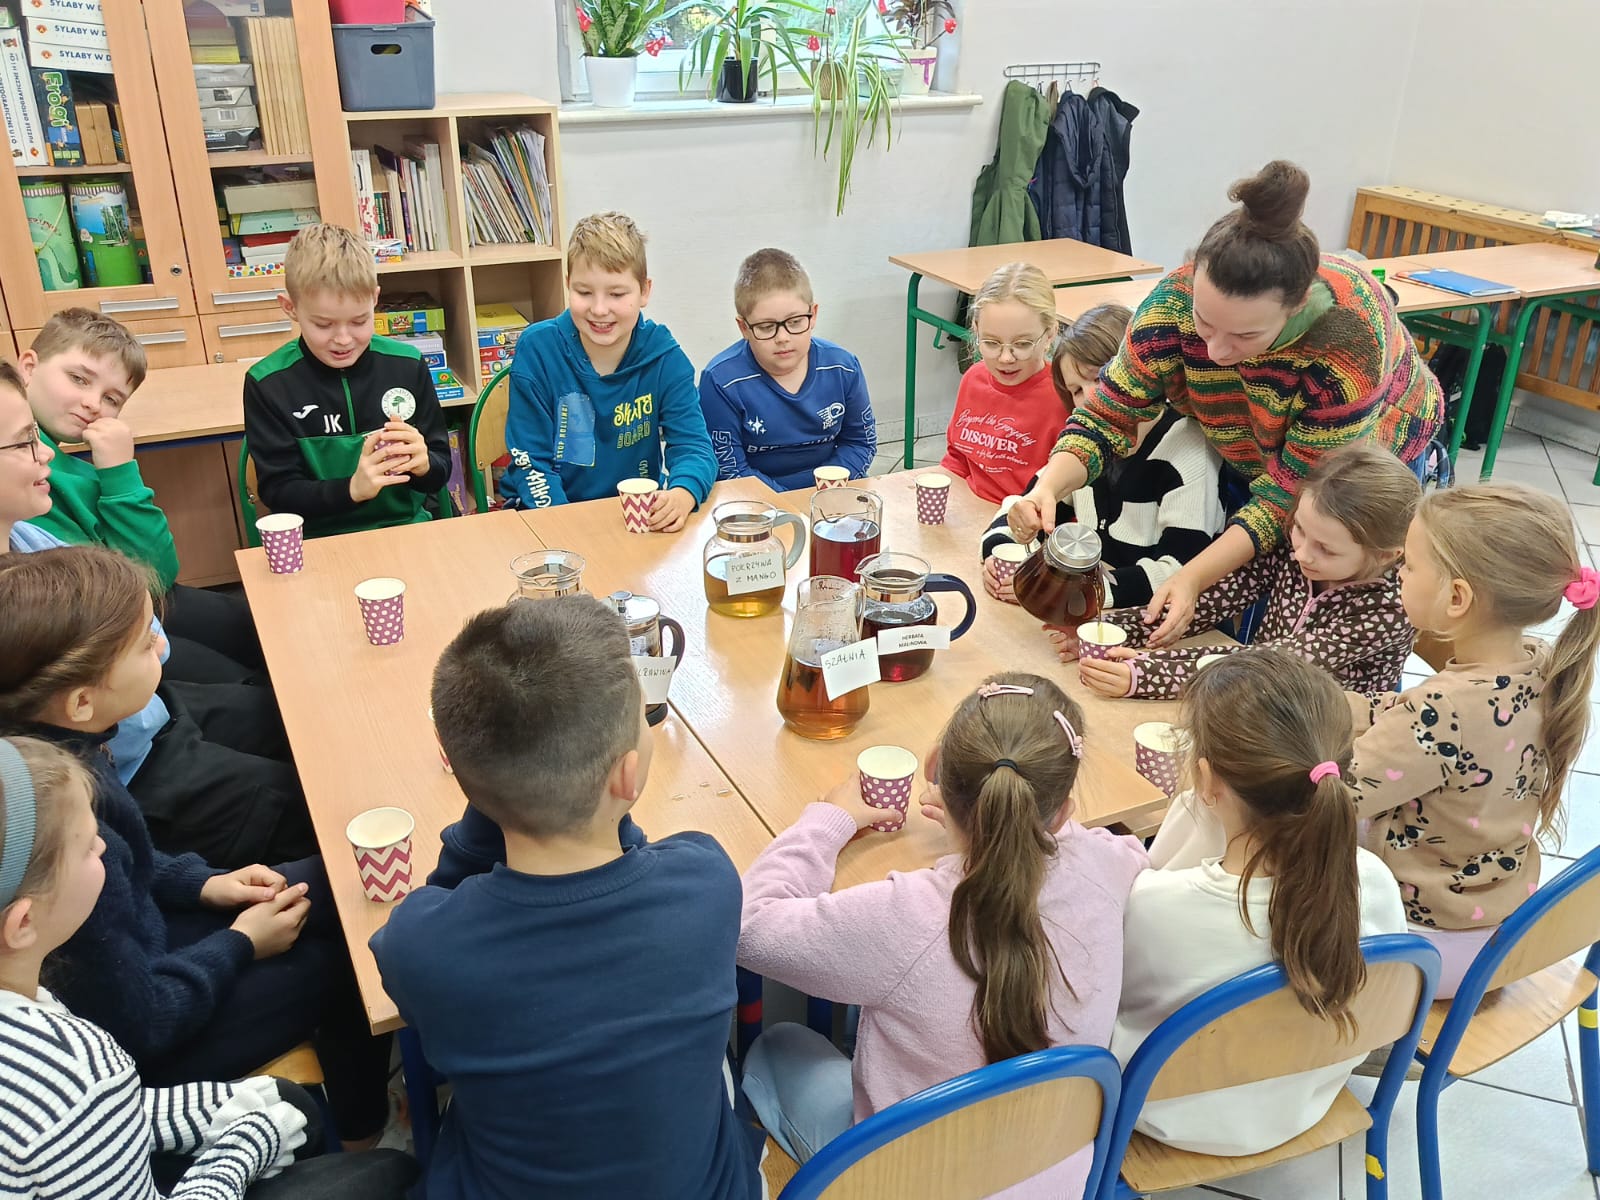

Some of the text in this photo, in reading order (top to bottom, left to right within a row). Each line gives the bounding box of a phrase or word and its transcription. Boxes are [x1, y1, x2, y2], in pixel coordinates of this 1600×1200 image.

[50, 0, 83, 9] SYLABY
[55, 25, 87, 34] SYLABY
[59, 50, 92, 60] SYLABY
[42, 72, 70, 127] Frogi
[323, 414, 343, 433] JK
[617, 421, 651, 449] BOARD
[960, 427, 1018, 454] DISCOVER
